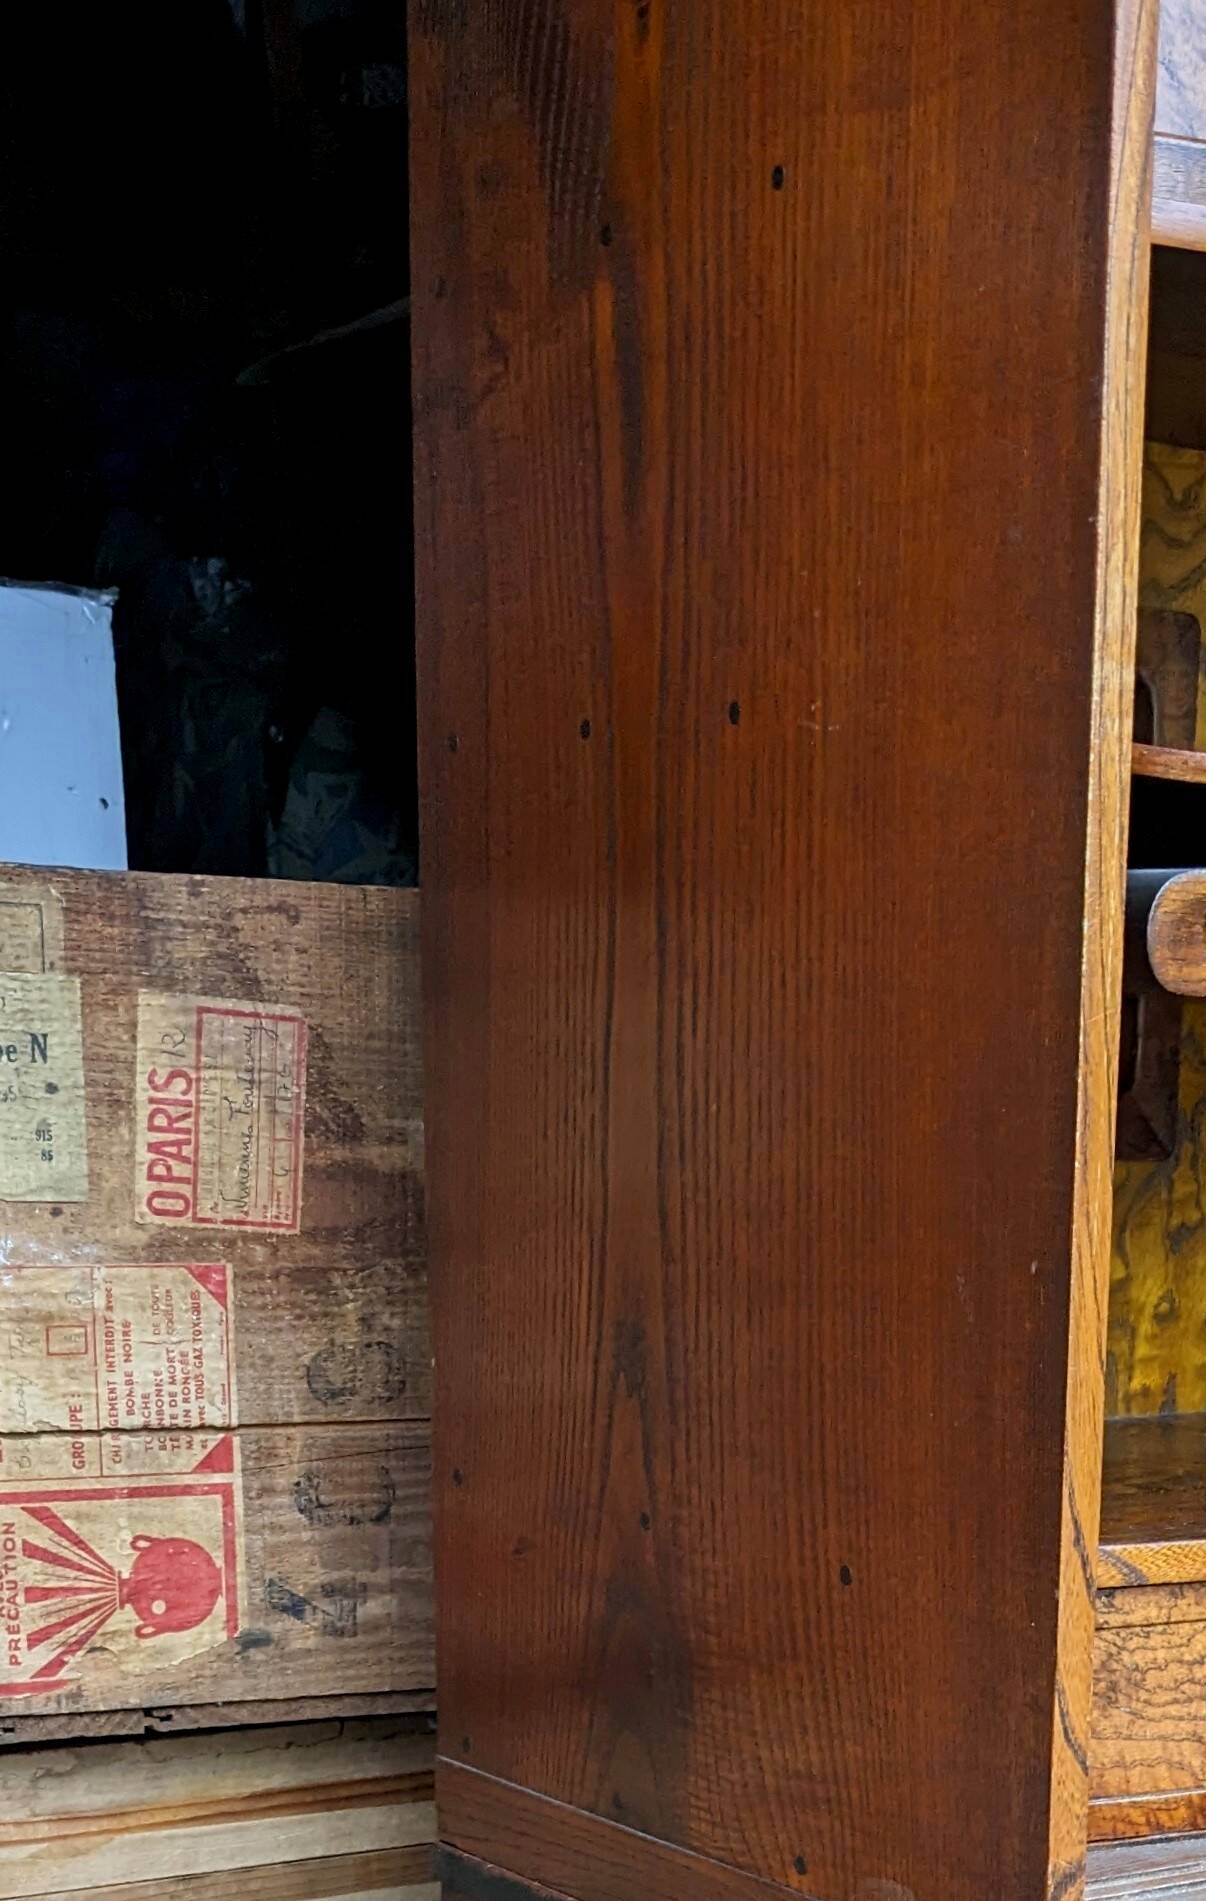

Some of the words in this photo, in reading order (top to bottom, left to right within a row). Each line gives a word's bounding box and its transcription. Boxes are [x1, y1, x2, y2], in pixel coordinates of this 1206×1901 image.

[31, 1033, 48, 1064] N
[104, 1315, 116, 1373] INTERDIT
[193, 1346, 203, 1370] GAZ
[166, 1347, 177, 1386] MORT
[124, 1370, 136, 1416] BOMBE
[168, 1391, 178, 1408] DE
[194, 1372, 205, 1400] TOUS
[3, 1522, 22, 1666] PRÉCAUTION
